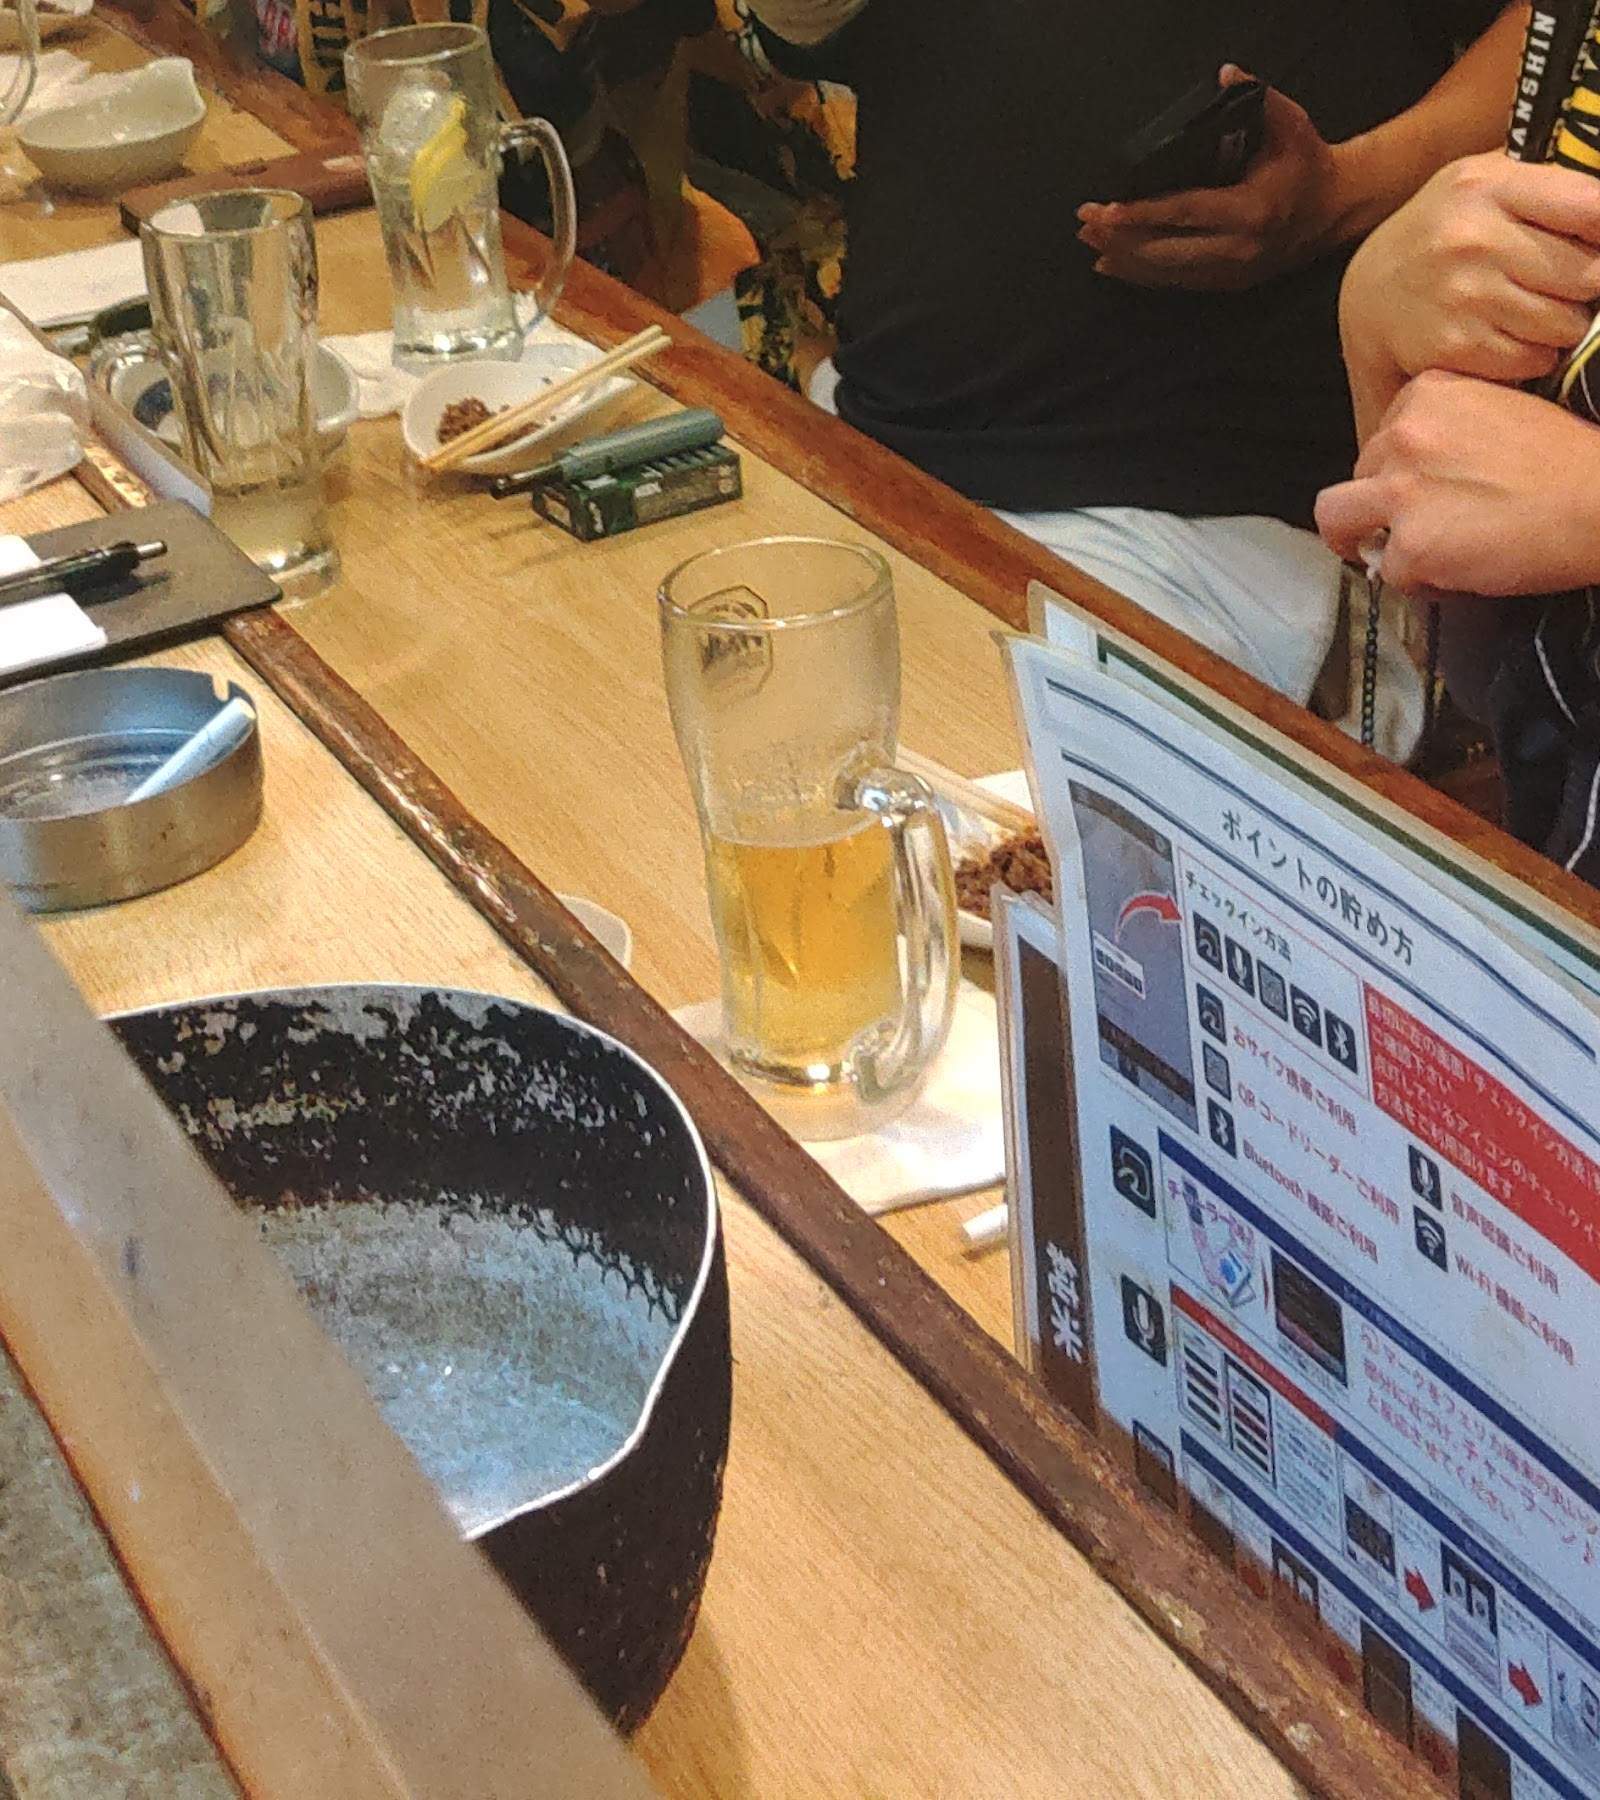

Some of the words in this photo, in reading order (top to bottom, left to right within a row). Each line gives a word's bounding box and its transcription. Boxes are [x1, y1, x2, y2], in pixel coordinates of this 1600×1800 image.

[1185, 870, 1293, 961] チェックイン方法
[1222, 808, 1414, 966] ポイントの貯め方
